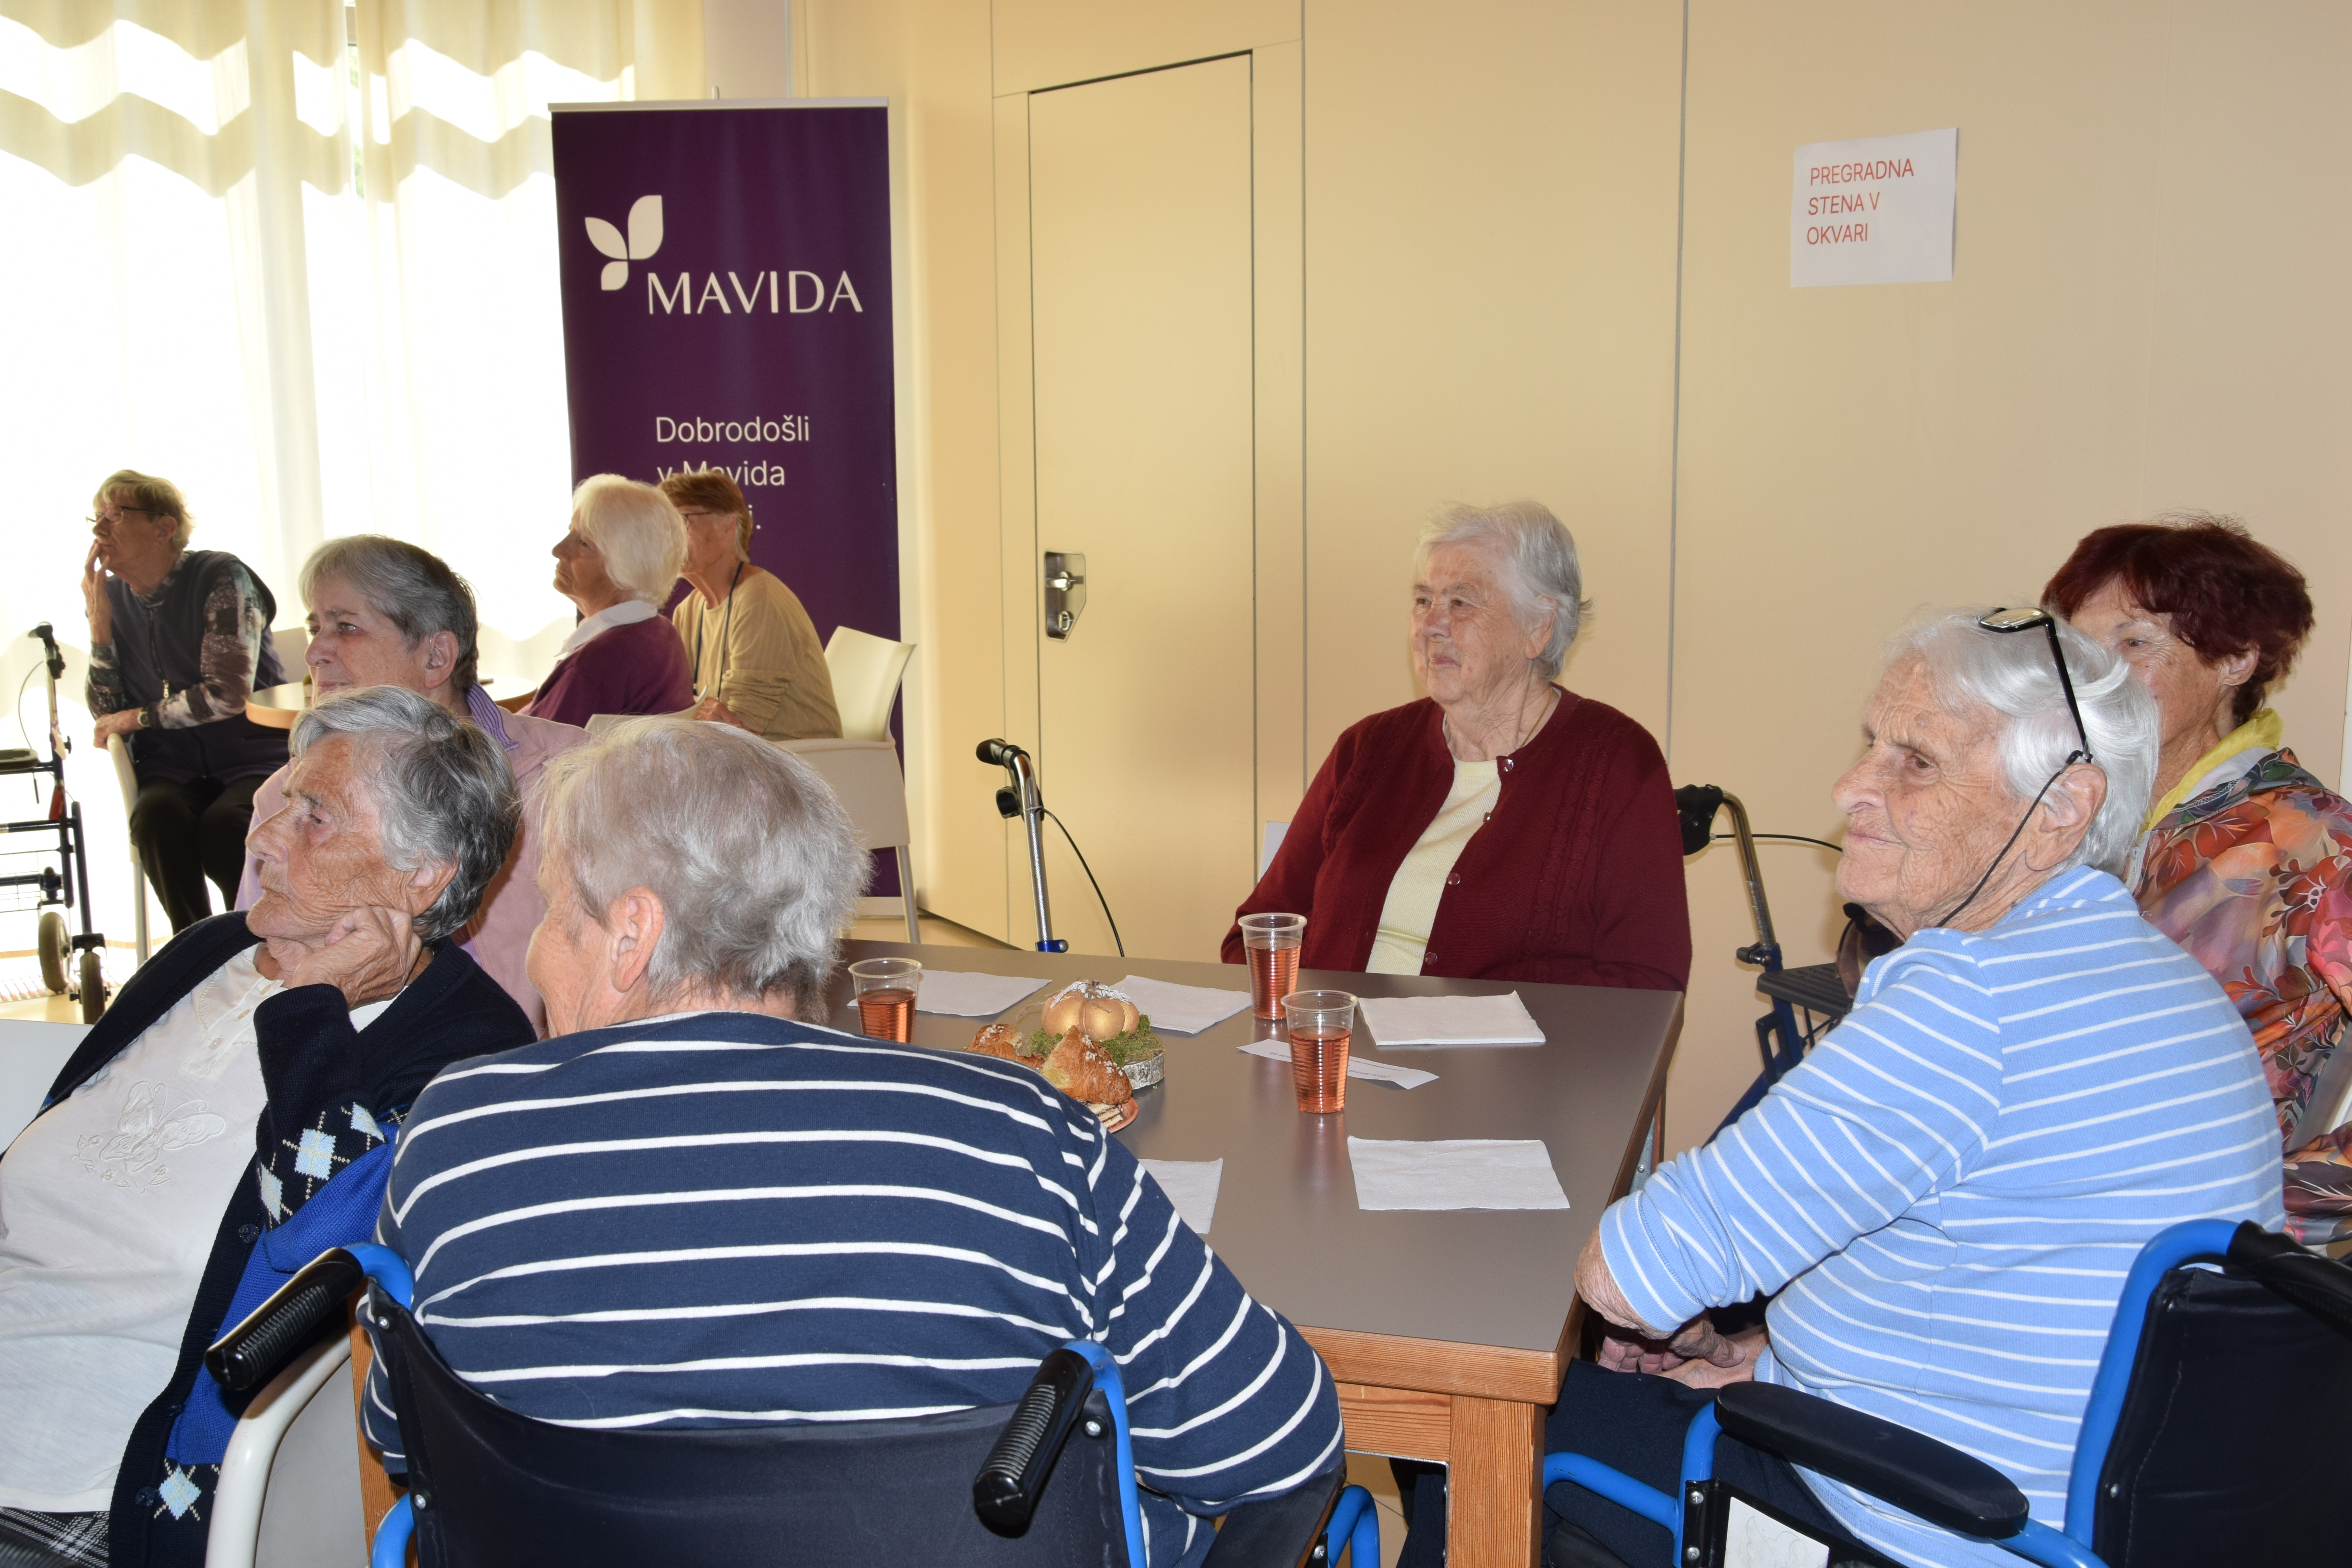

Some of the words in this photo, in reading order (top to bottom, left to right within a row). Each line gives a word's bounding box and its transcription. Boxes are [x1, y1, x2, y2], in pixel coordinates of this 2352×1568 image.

[1811, 158, 1914, 185] PREGRADNA
[1808, 194, 1864, 215] STENA
[1869, 192, 1880, 210] V
[1807, 223, 1868, 245] OKVARI
[648, 270, 863, 314] MAVIDA
[656, 415, 809, 443] Dobrodošli
[657, 467, 673, 482] v
[683, 460, 785, 486] Mvida
